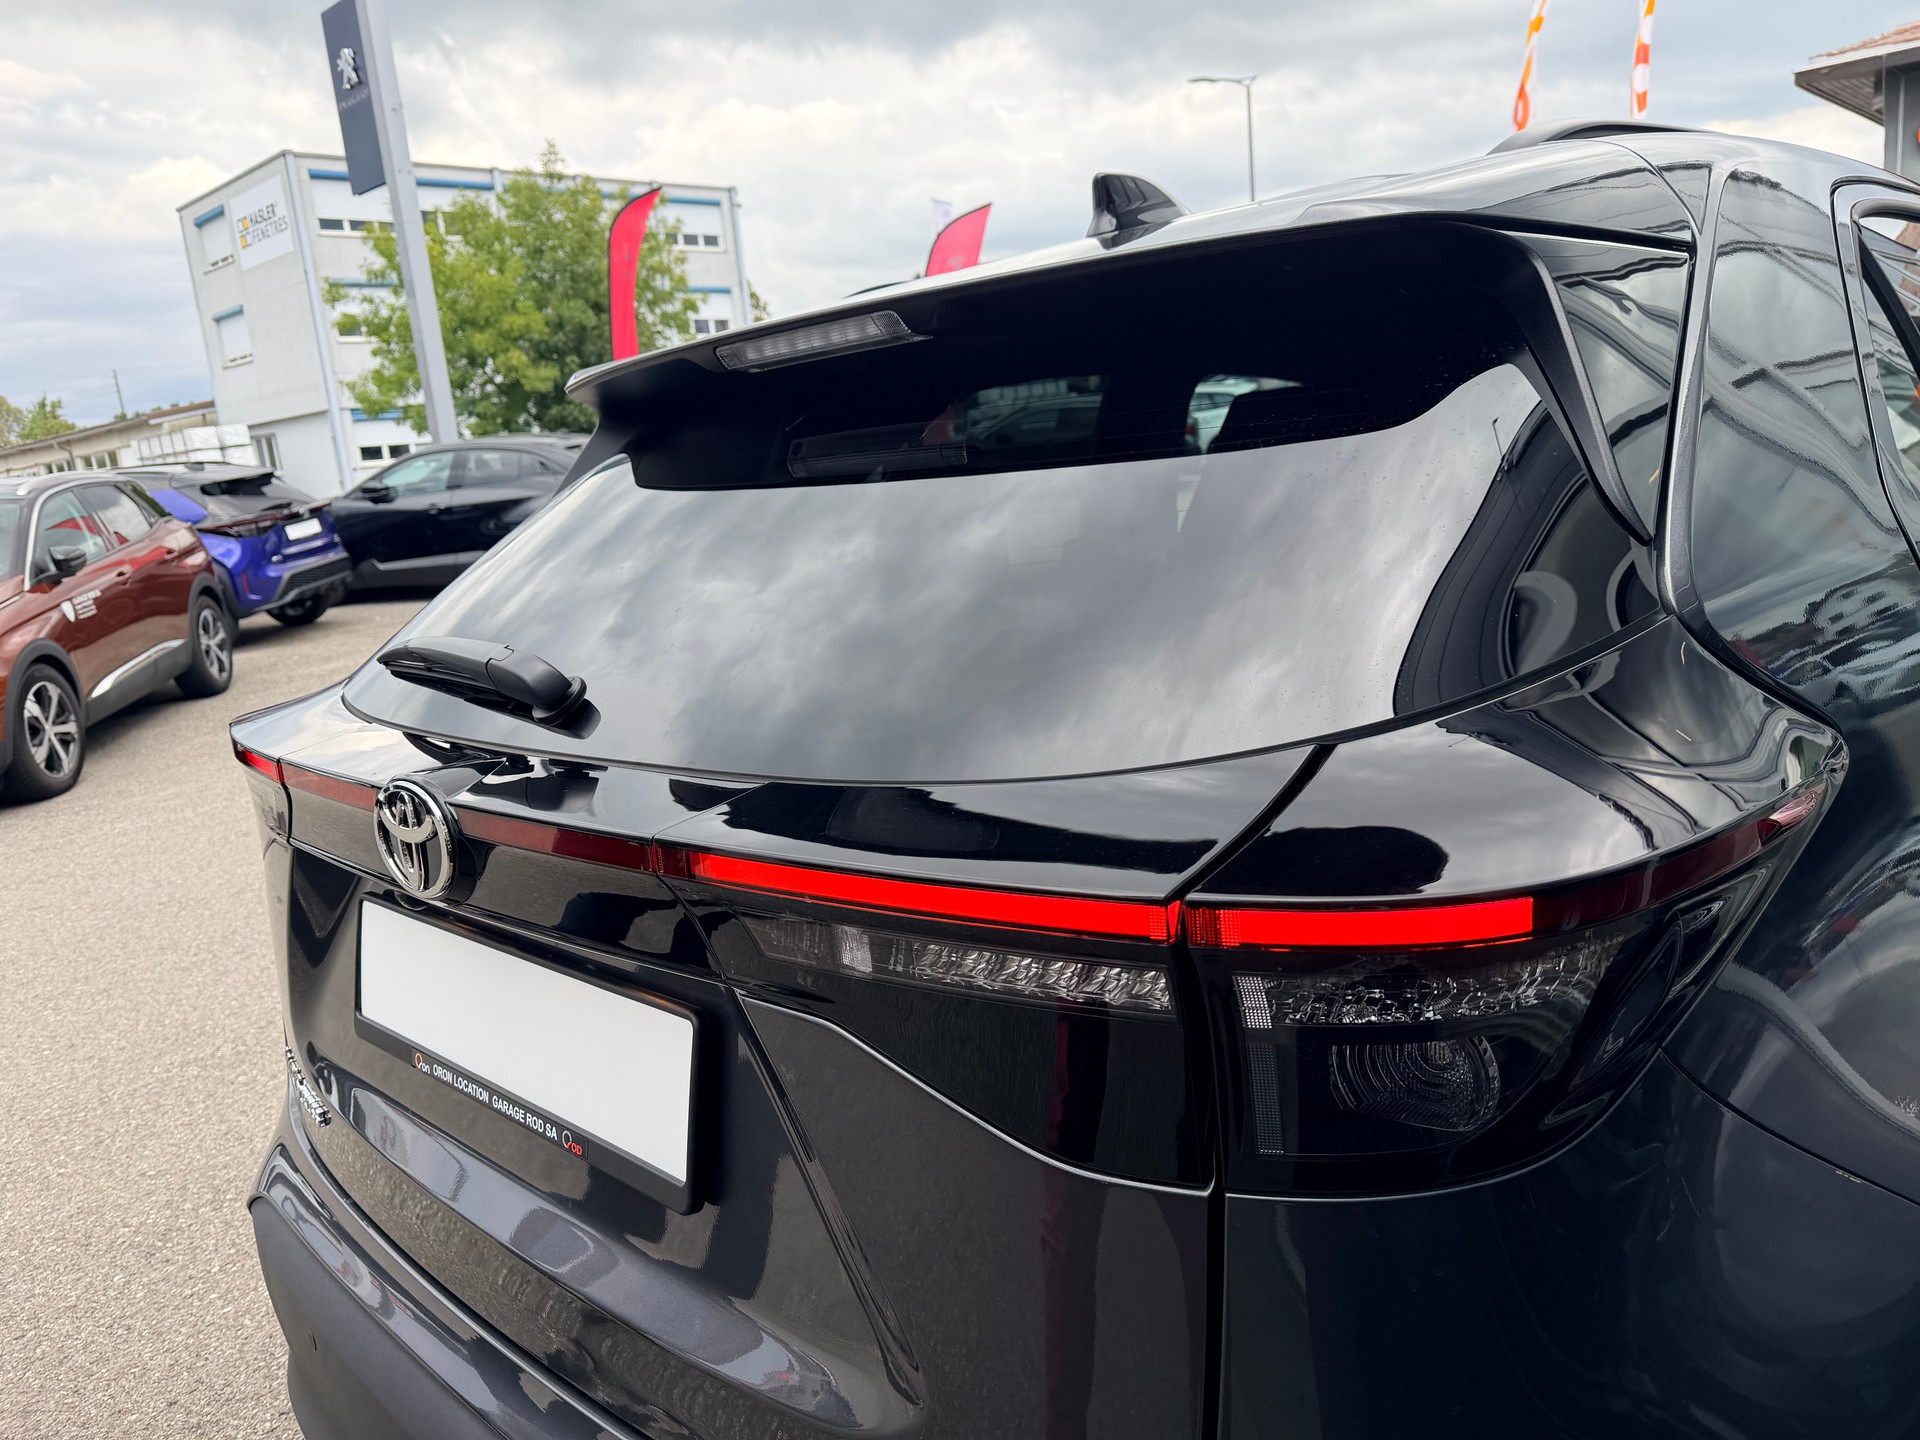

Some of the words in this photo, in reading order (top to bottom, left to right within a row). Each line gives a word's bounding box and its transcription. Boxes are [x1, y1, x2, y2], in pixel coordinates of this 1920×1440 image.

[433, 1063, 452, 1084] ORON
[453, 1074, 489, 1103] LOCATION
[492, 1095, 525, 1123] GARAGE
[526, 1112, 544, 1133] ROD
[545, 1123, 558, 1141] SA
